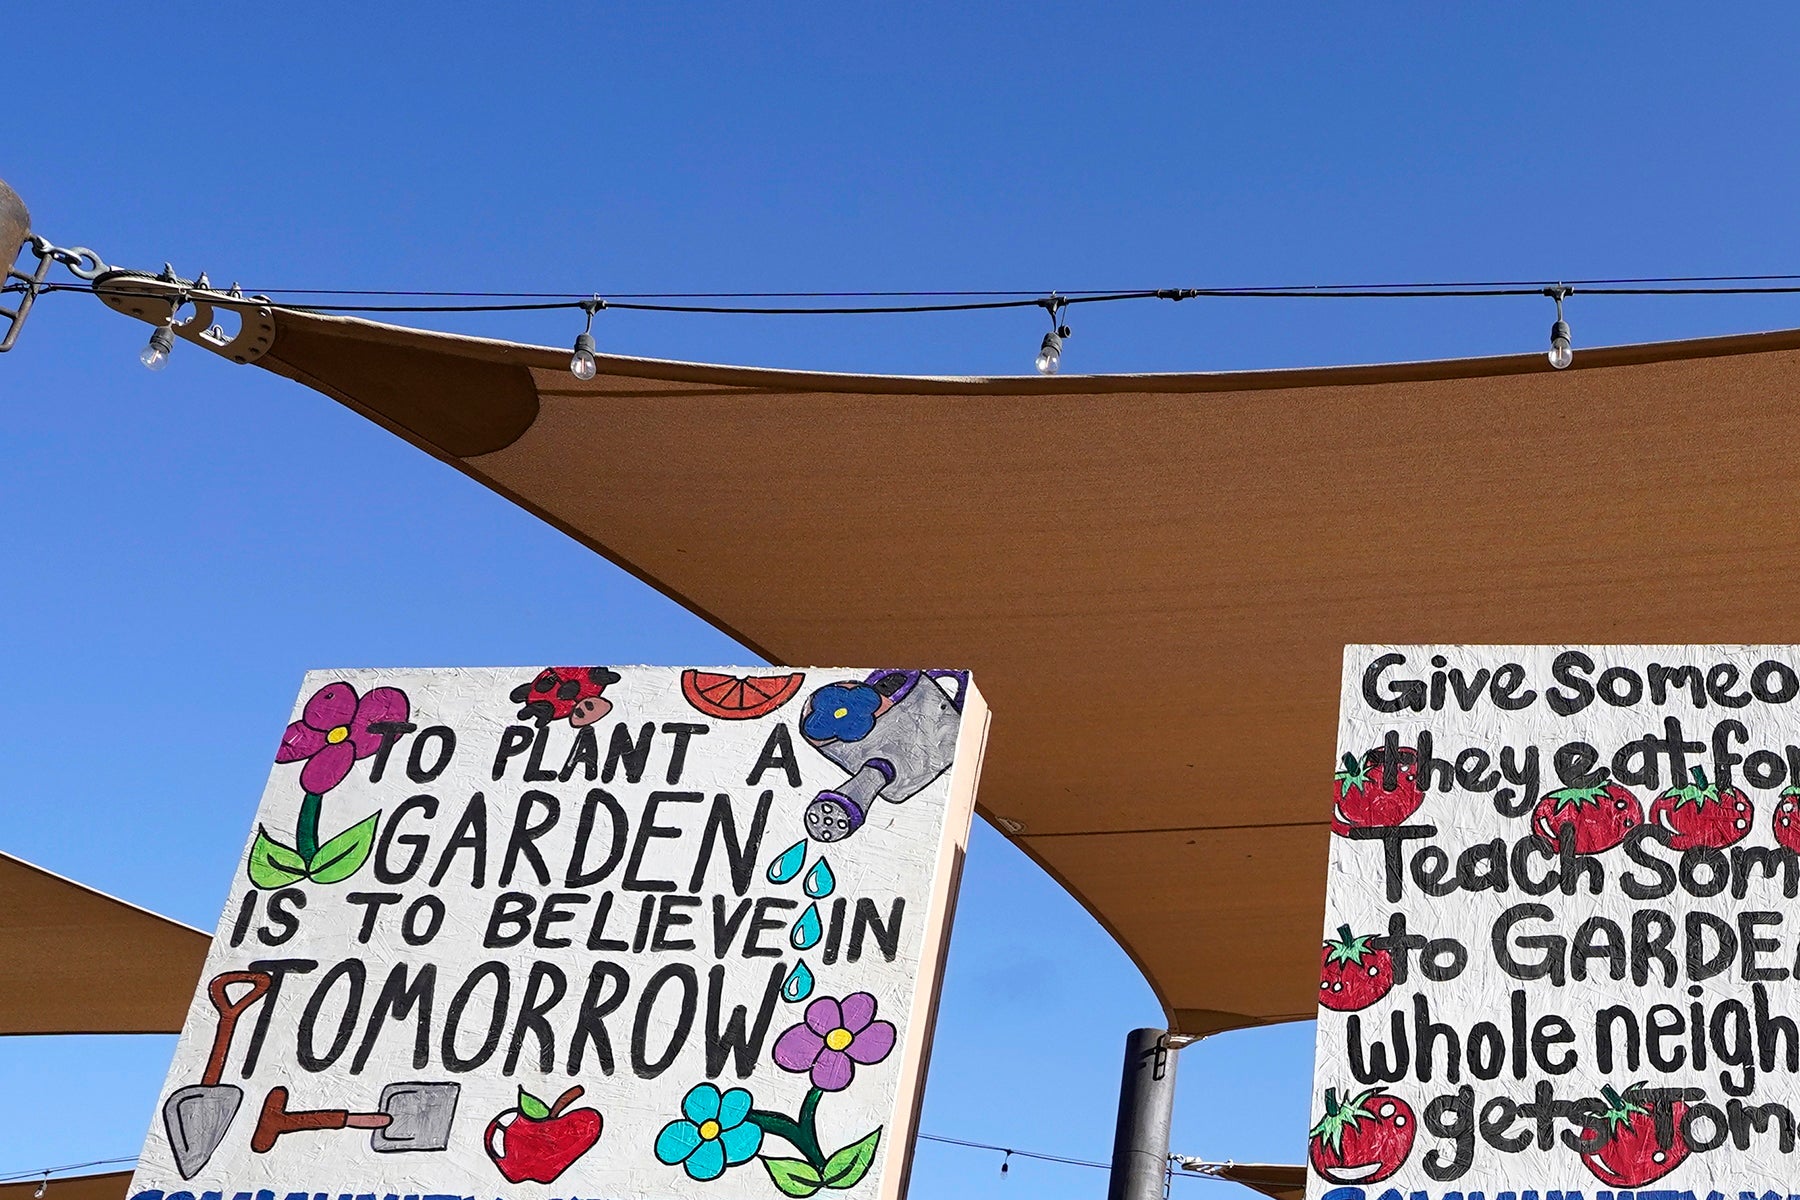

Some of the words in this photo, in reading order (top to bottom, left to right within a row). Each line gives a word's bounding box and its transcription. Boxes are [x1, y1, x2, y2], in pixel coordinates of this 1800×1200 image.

[1362, 654, 1537, 712] Give
[366, 723, 455, 783] TO
[492, 722, 709, 782] PLANT
[746, 724, 803, 788] A
[1341, 731, 1540, 817] they
[1554, 718, 1706, 791] eat
[374, 791, 773, 895] GARDEN
[1350, 821, 1601, 903] Teach
[230, 889, 307, 947] IS
[346, 892, 445, 946] TO
[483, 891, 798, 957] BELIEVE
[823, 896, 904, 964] IN
[1382, 912, 1468, 985] to
[241, 958, 788, 1079] TOMORROW
[1423, 1083, 1605, 1182] gets
